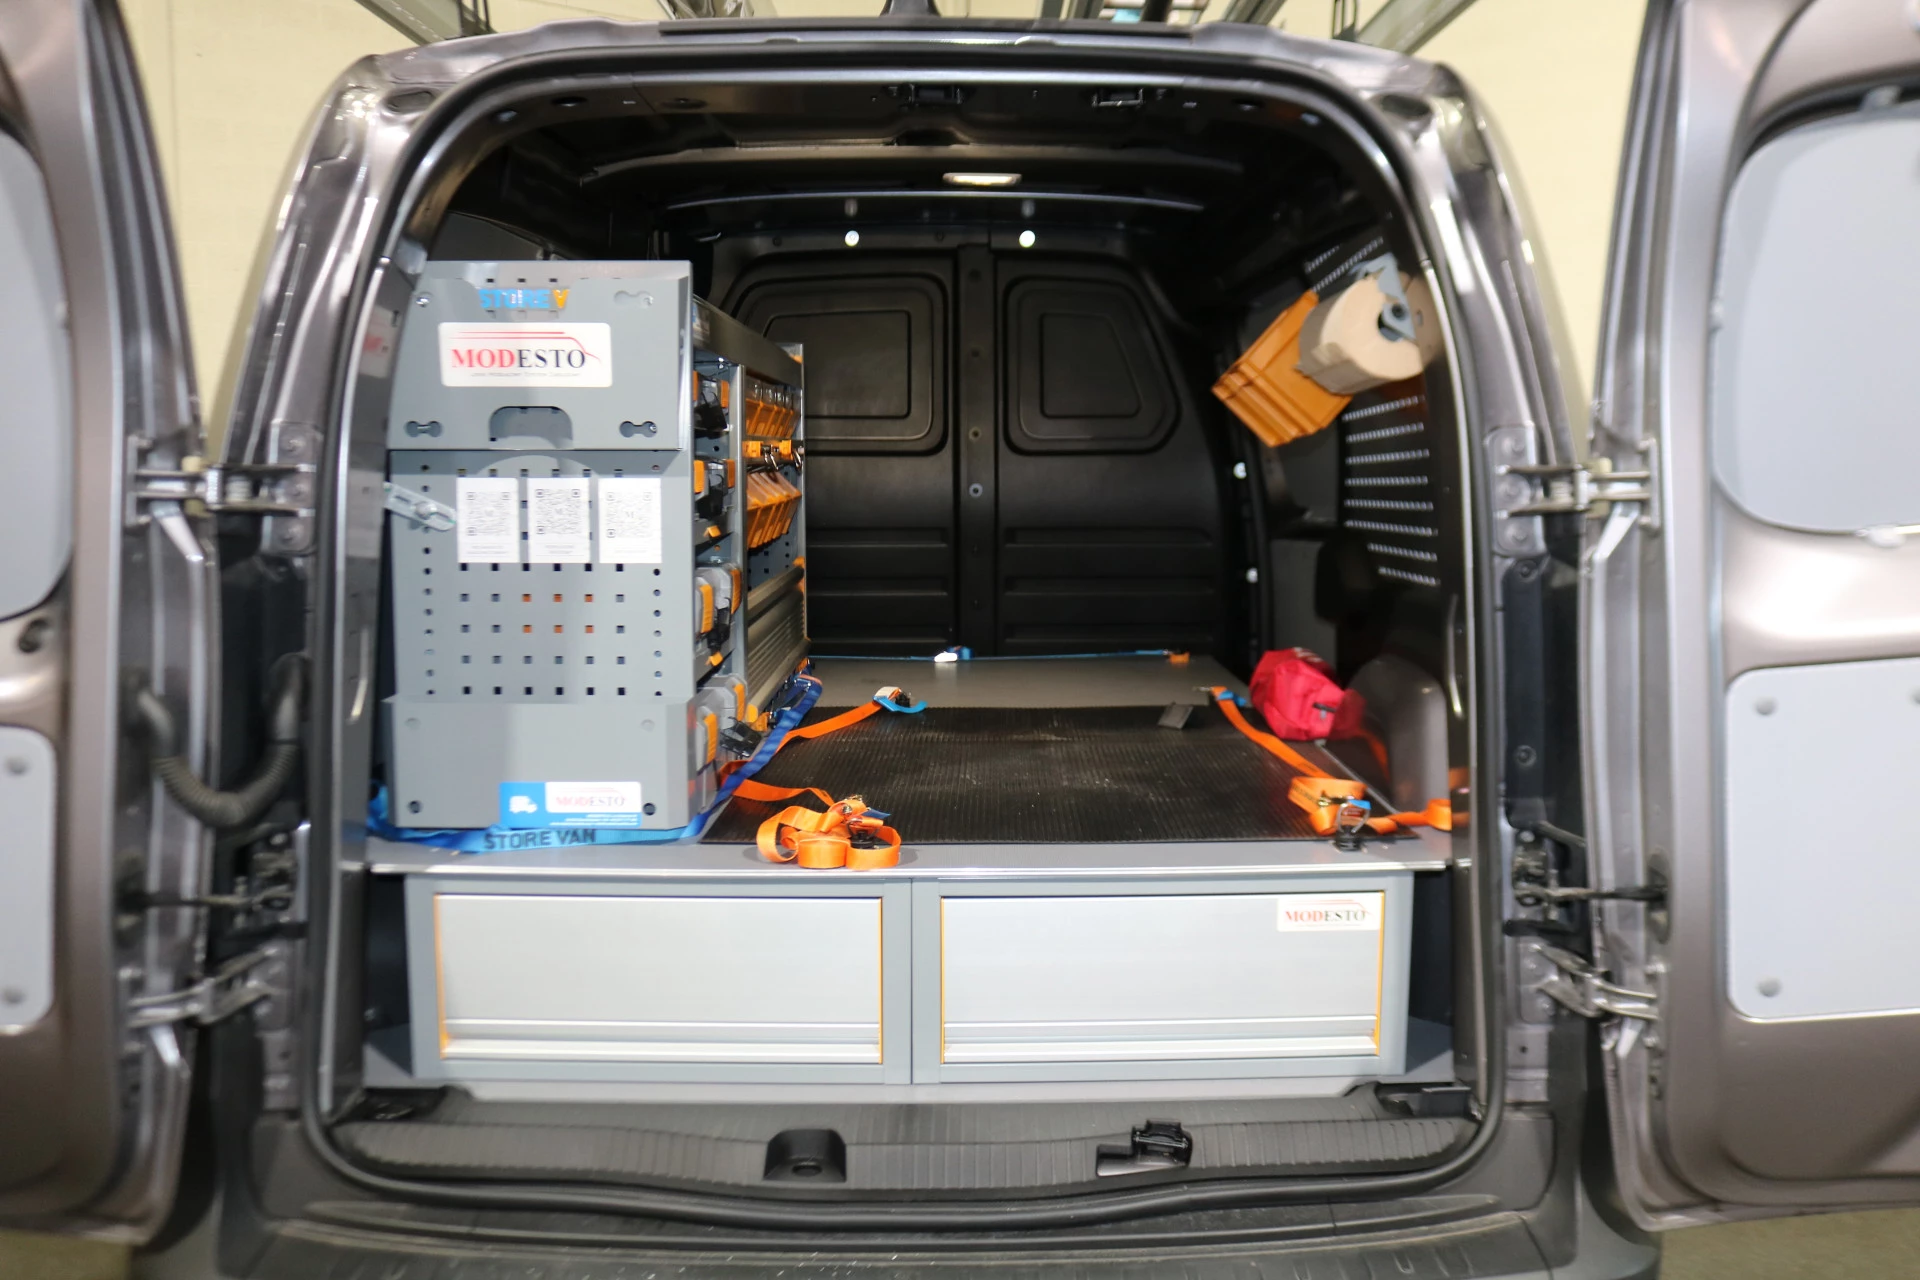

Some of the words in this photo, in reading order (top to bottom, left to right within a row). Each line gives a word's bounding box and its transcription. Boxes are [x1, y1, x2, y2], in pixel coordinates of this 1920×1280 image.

[479, 289, 549, 308] STORE
[452, 349, 586, 368] MODESTO
[555, 796, 626, 807] MODESTO
[484, 831, 551, 850] STORE
[1285, 911, 1366, 922] MODESTO
